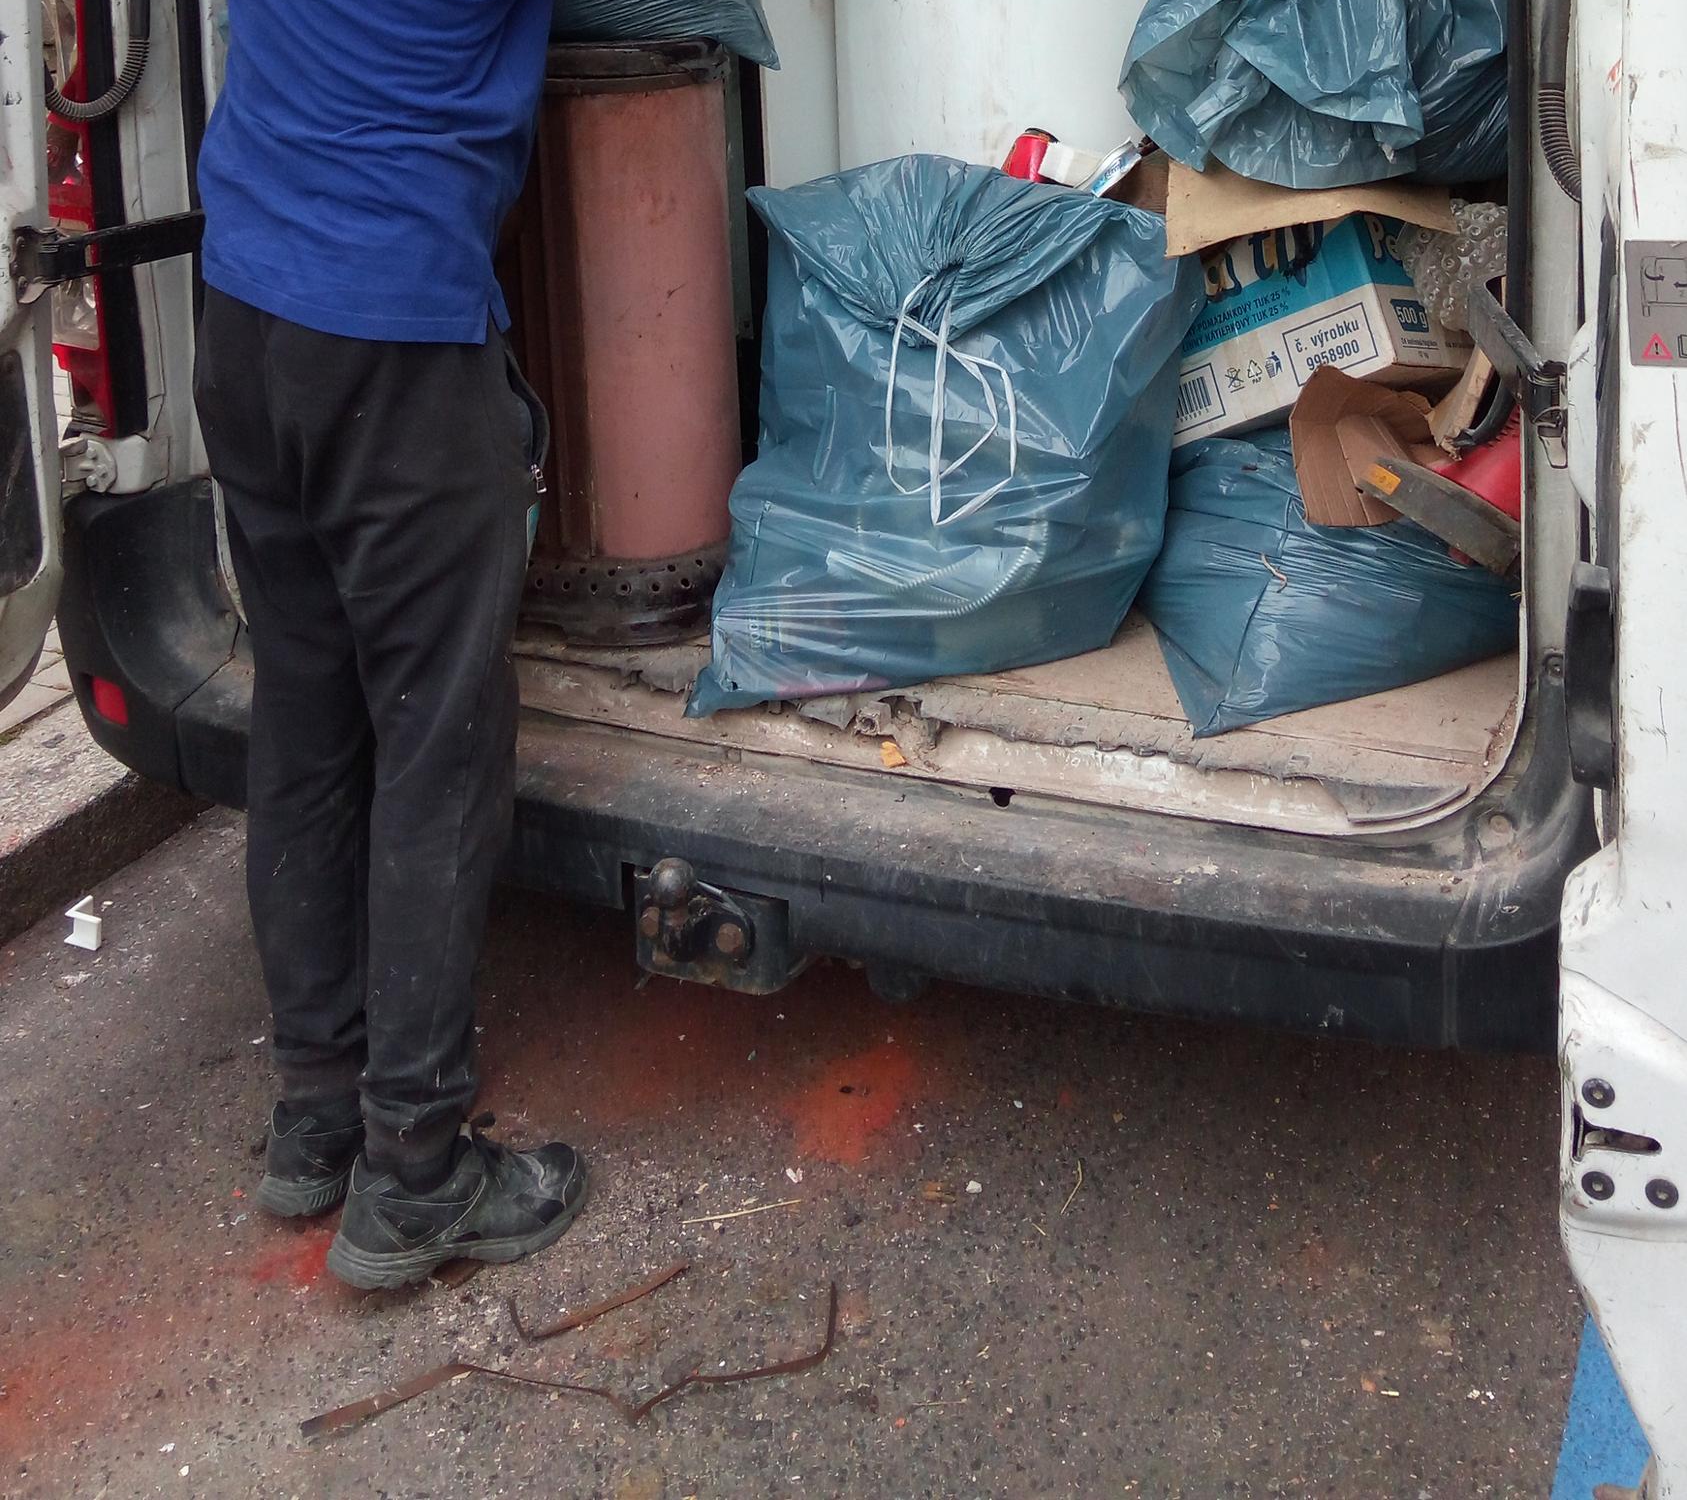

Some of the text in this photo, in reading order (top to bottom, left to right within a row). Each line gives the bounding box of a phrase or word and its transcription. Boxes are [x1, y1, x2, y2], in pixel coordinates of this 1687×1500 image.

[1395, 305, 1428, 329] 500 g
[1310, 318, 1360, 349] výrobku
[1306, 339, 1360, 371] 9958900
